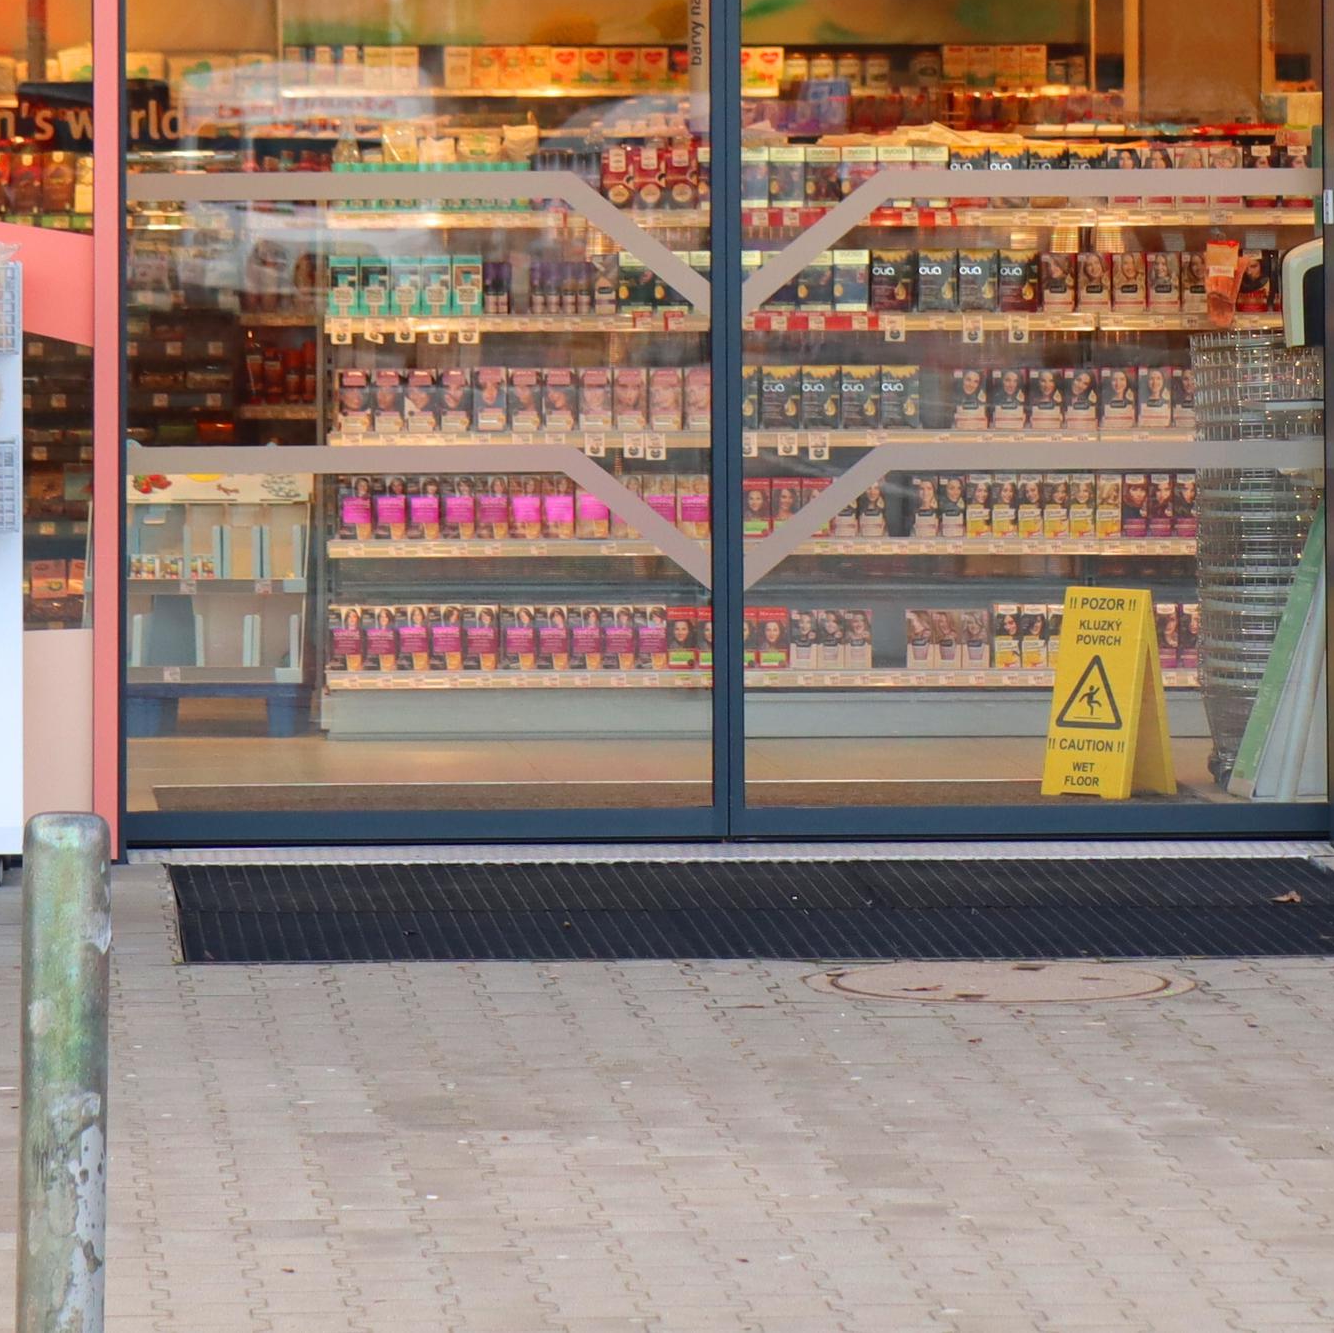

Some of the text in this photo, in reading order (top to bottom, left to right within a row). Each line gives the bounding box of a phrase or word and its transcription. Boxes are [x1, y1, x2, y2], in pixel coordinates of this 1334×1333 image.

[691, 21, 705, 66] barvy
[70, 100, 185, 142] wrld
[1080, 597, 1125, 611] POZOR
[1076, 635, 1122, 646] POVRCH
[1060, 738, 1114, 752] CAUTION
[1072, 762, 1095, 773] WET
[1064, 775, 1100, 787] FLOOR
